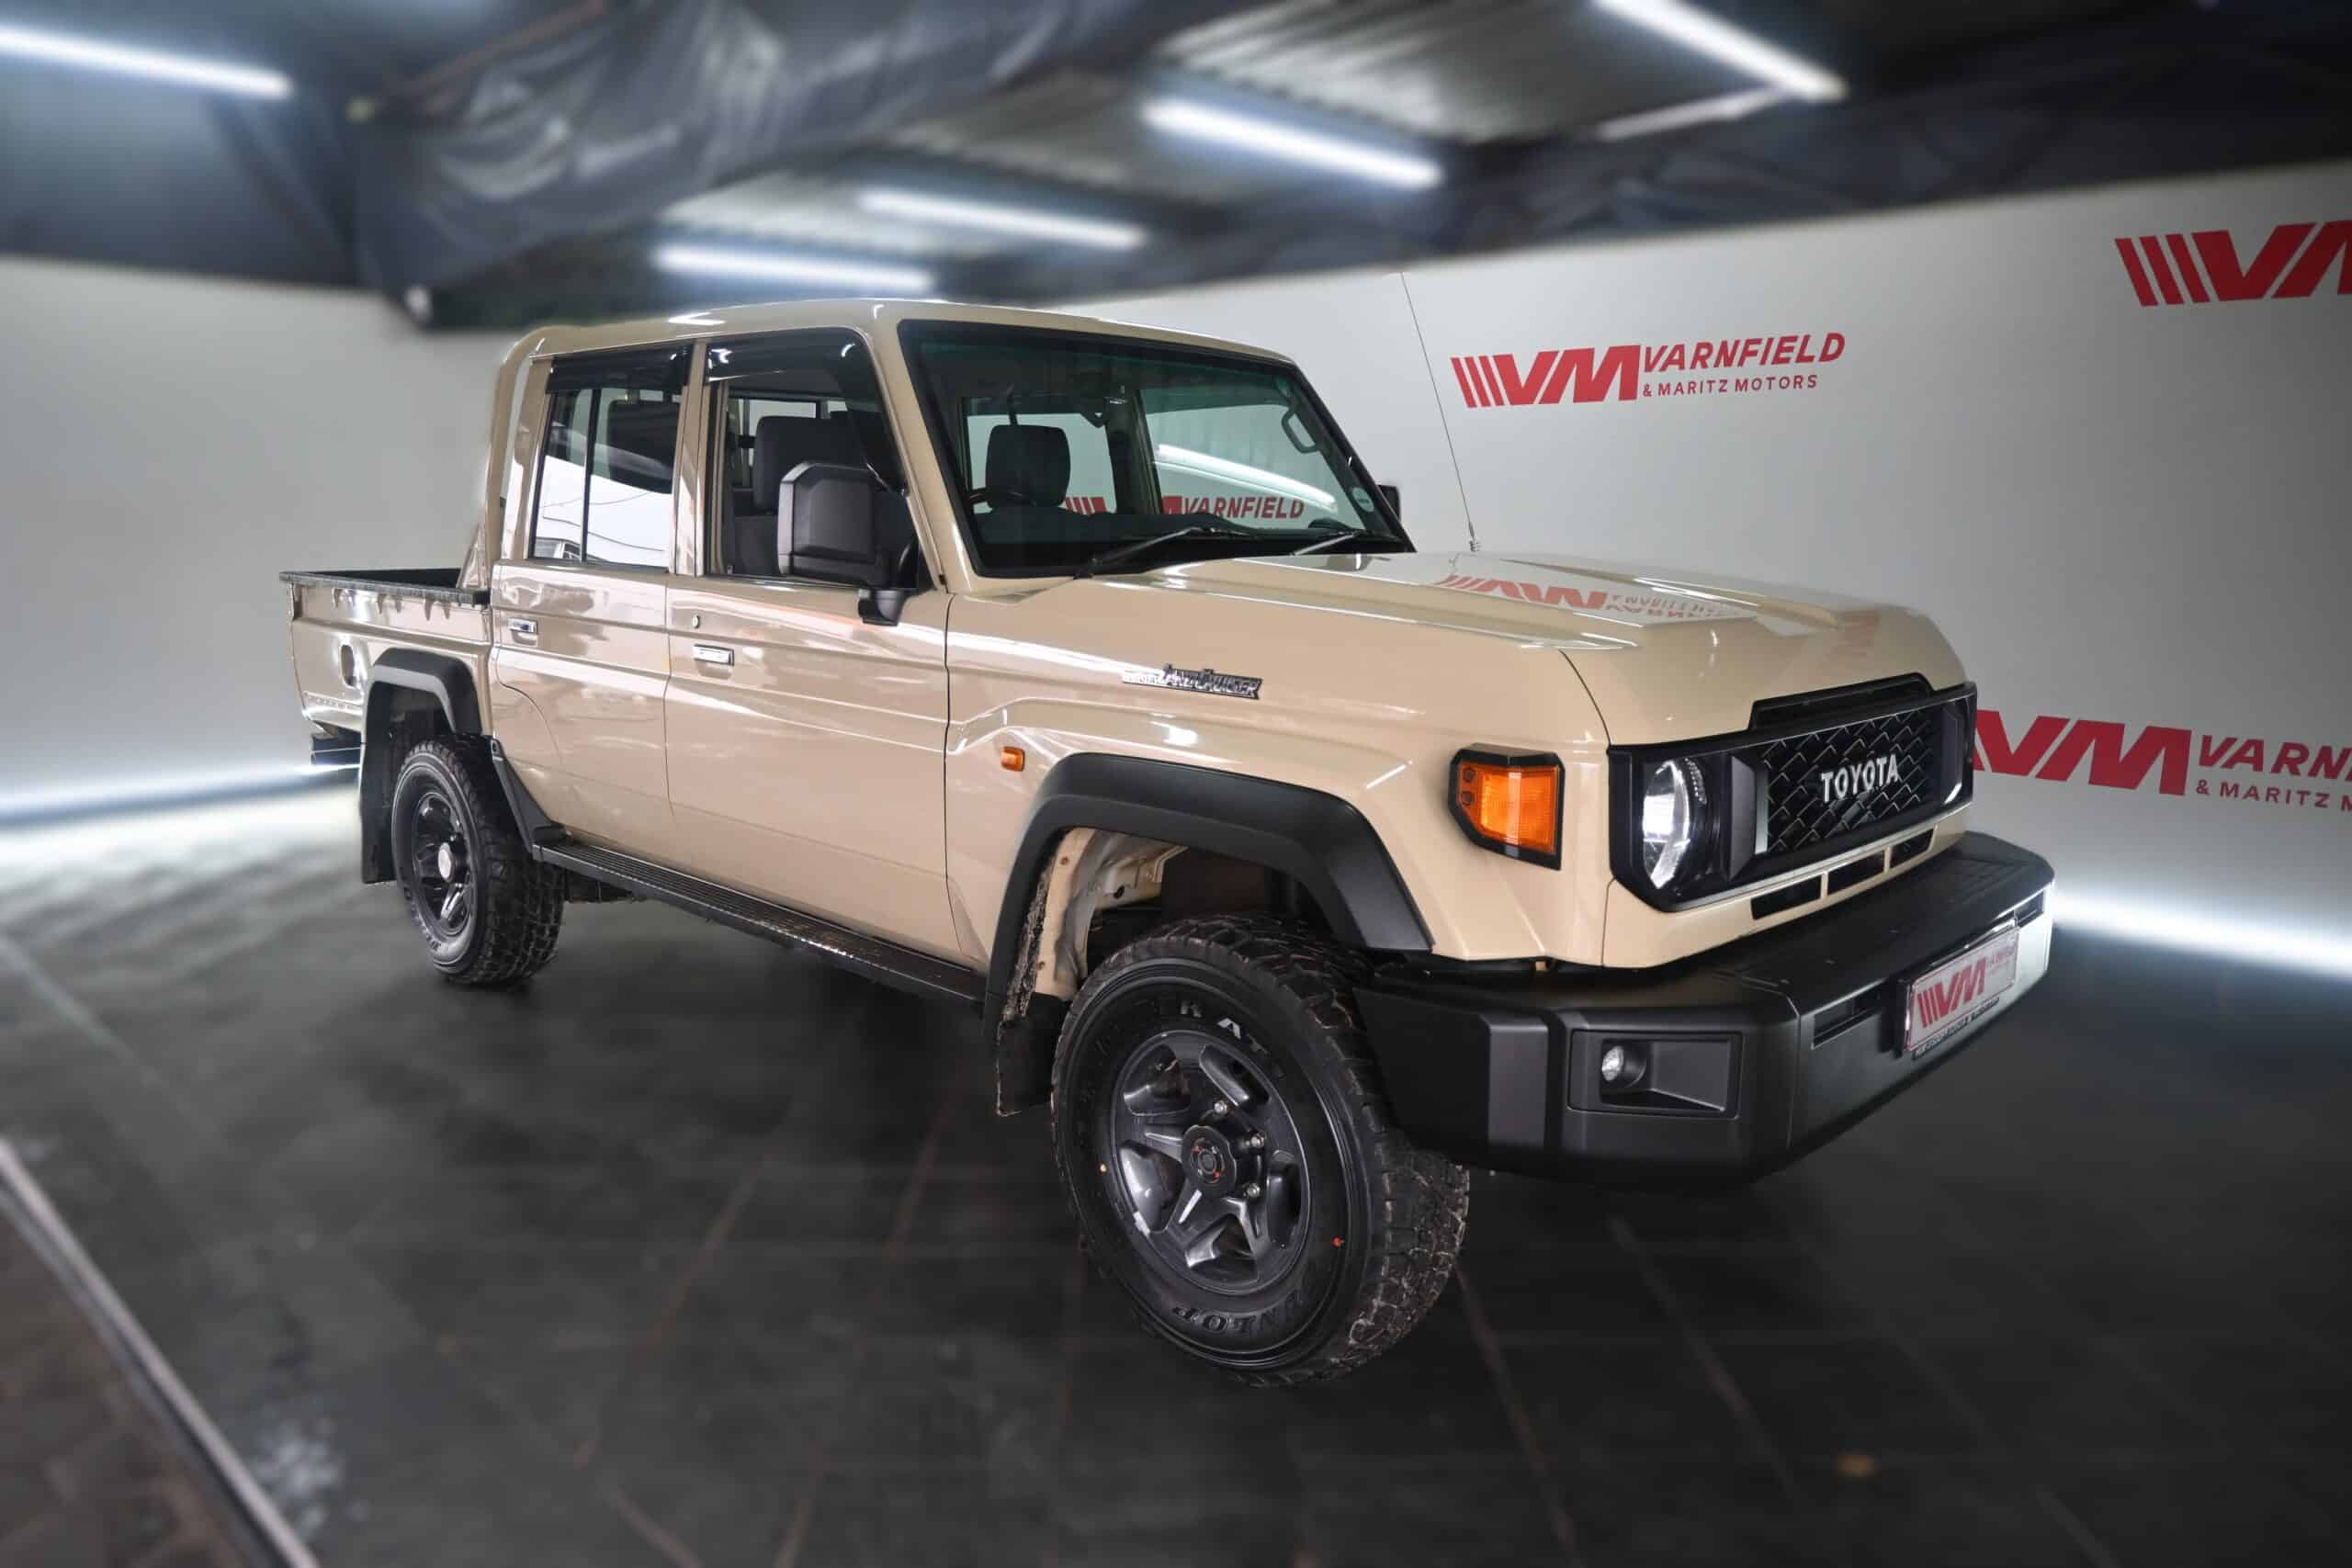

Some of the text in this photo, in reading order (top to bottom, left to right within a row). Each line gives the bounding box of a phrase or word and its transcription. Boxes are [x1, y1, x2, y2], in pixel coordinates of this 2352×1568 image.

[1644, 332, 1846, 373] VARNFIELD
[1491, 344, 1642, 406] VM
[1643, 374, 1818, 398] & MARITZ MOTORS
[1184, 496, 1306, 519] VARNFIELD
[1975, 709, 2193, 796] VM
[2199, 734, 2352, 782] VARN
[1821, 753, 1899, 803] TOYOTA
[2196, 779, 2211, 795] &
[2219, 781, 2331, 808] MARITZ
